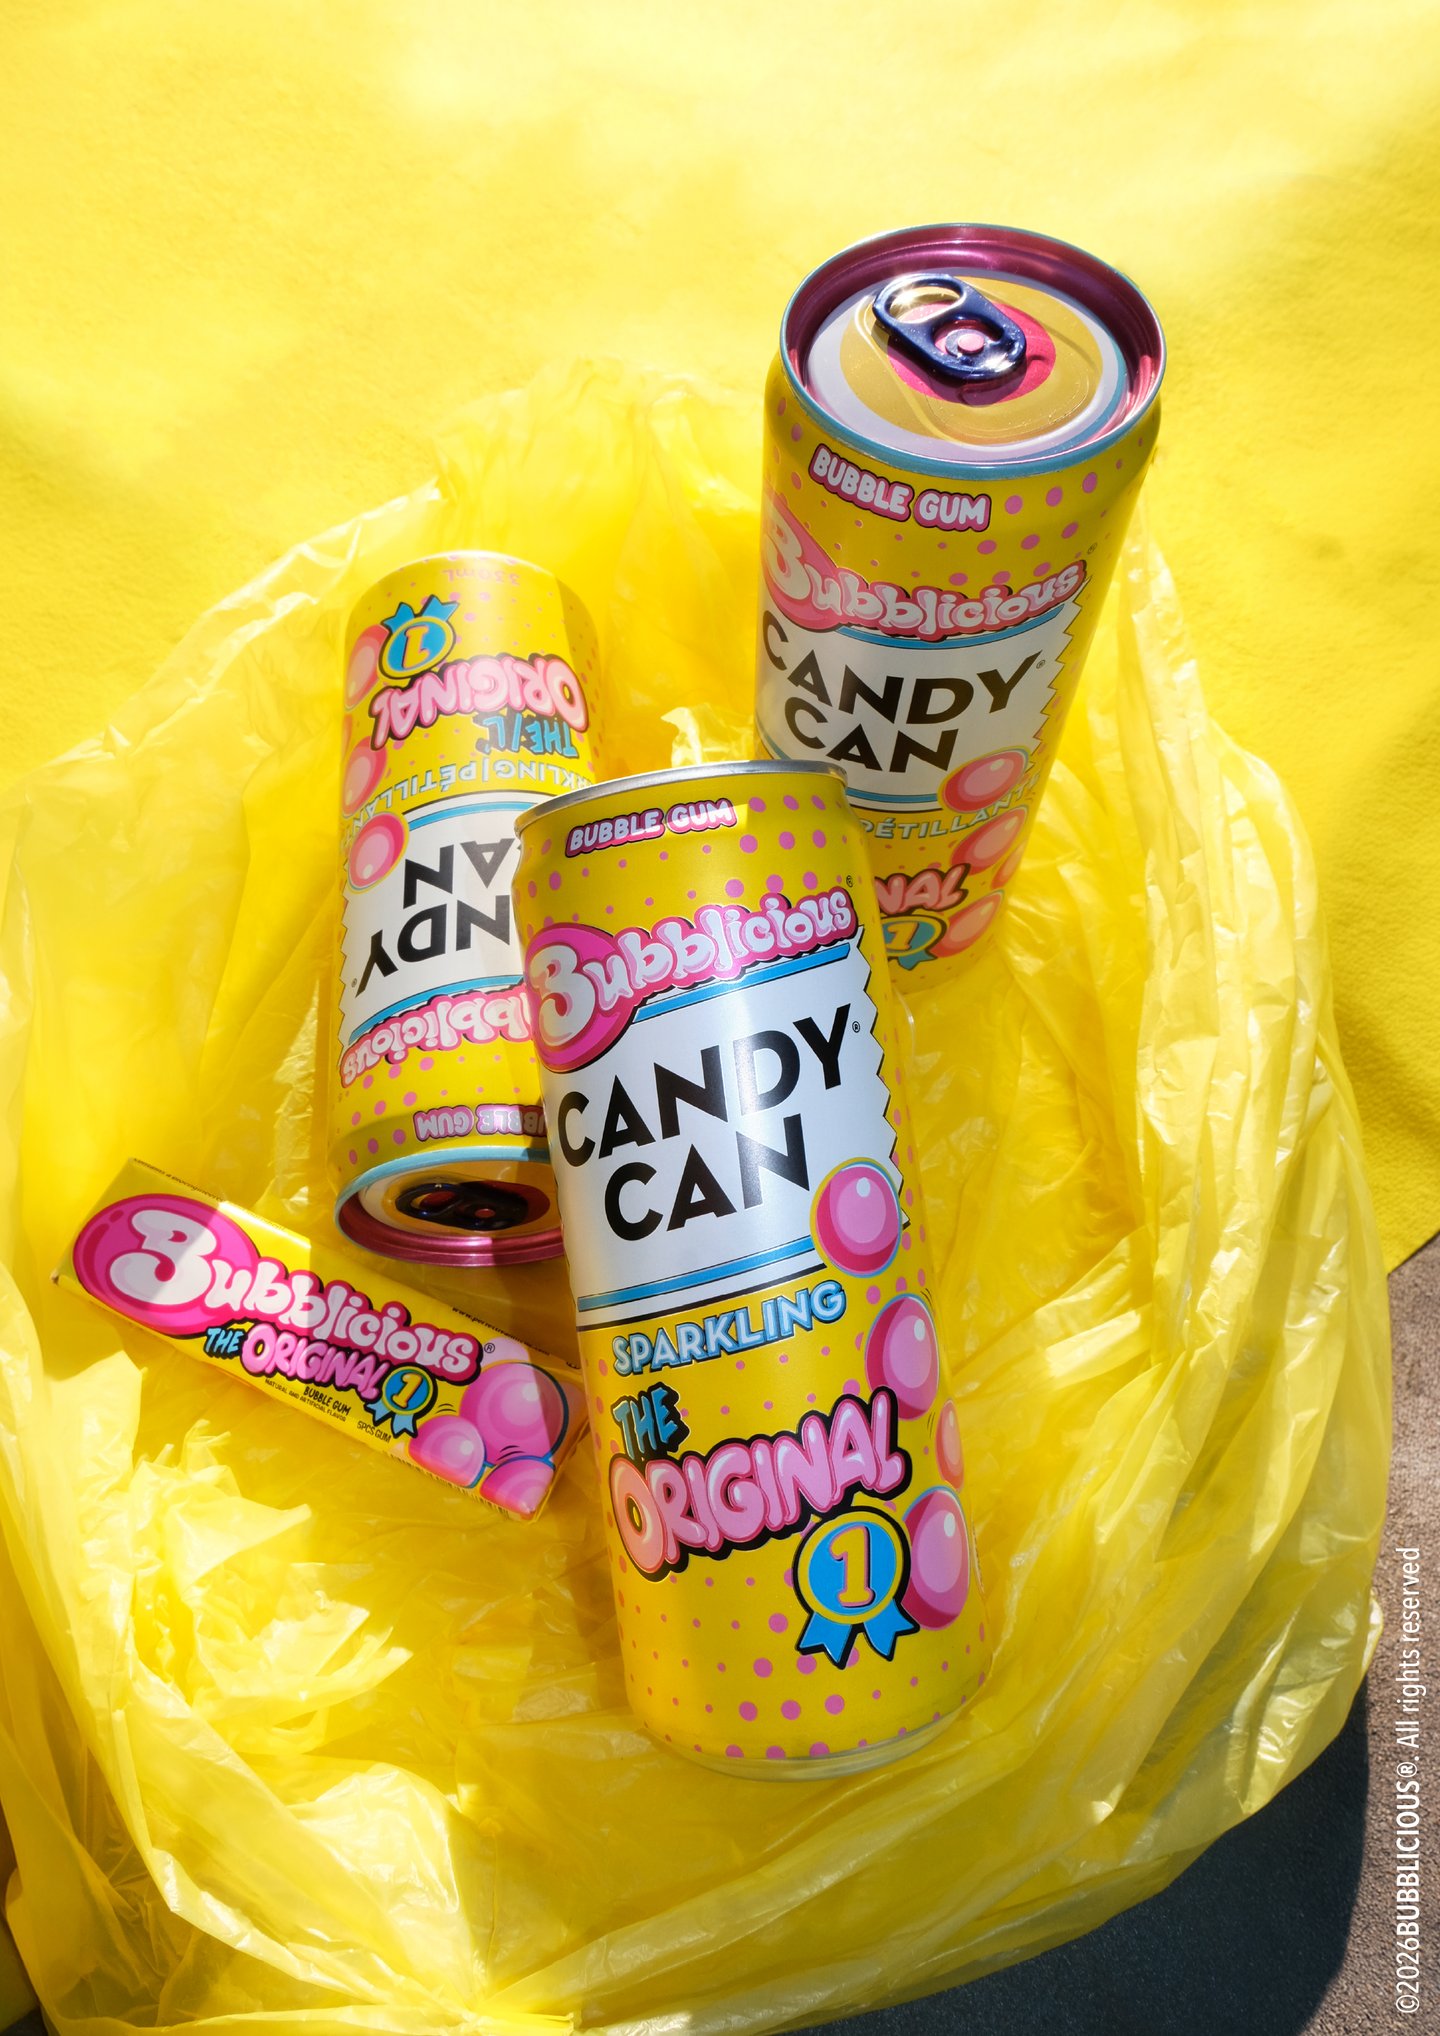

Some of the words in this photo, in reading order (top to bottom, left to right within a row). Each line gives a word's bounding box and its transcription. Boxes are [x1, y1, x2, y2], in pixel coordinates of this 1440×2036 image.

[811, 446, 911, 516] BUBBLE
[917, 490, 989, 526] GUM
[401, 624, 430, 670] 1
[371, 654, 588, 749] ORIGINAL
[784, 696, 959, 773] CAN
[568, 810, 663, 854] BUBBLE
[667, 799, 737, 832] GUM
[402, 837, 519, 910] AN
[886, 922, 919, 950] 1
[414, 1104, 474, 1141] GUM
[604, 1112, 810, 1242] CAN
[204, 1327, 243, 1356] THE
[240, 1323, 389, 1400] ORIGINAL
[612, 1280, 847, 1376] SPARKLING
[303, 1385, 333, 1407] BUBBLE
[332, 1400, 352, 1416] GUM
[392, 1372, 423, 1410] 1
[612, 1384, 681, 1460] THE
[374, 1428, 392, 1443] GUM
[610, 1389, 908, 1577] ORIGINAL
[829, 1524, 877, 1607] 1
